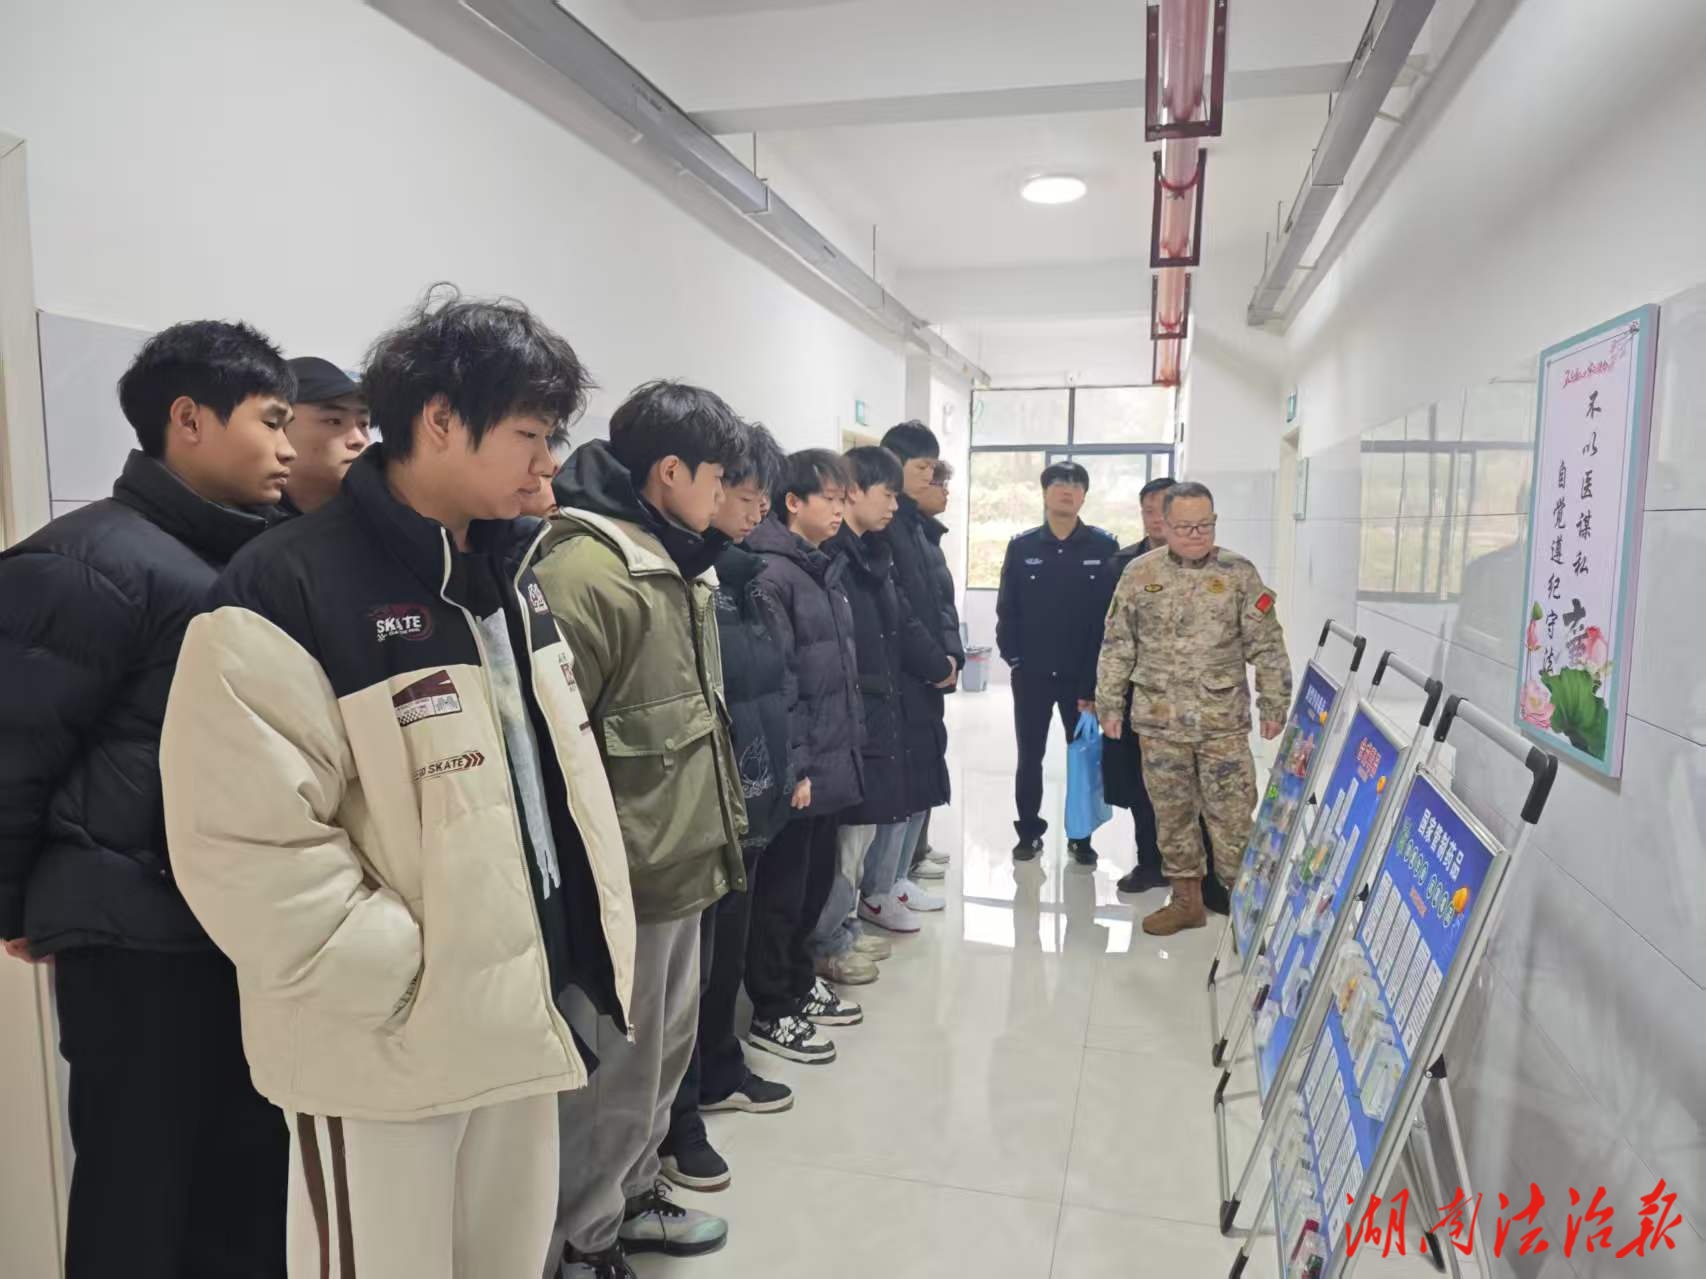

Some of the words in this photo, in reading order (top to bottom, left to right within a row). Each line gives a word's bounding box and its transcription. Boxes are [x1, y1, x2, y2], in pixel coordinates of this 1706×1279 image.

[1573, 390, 1602, 576] 不以医谋私
[376, 616, 421, 633] SKATE
[427, 758, 464, 774] SKATE
